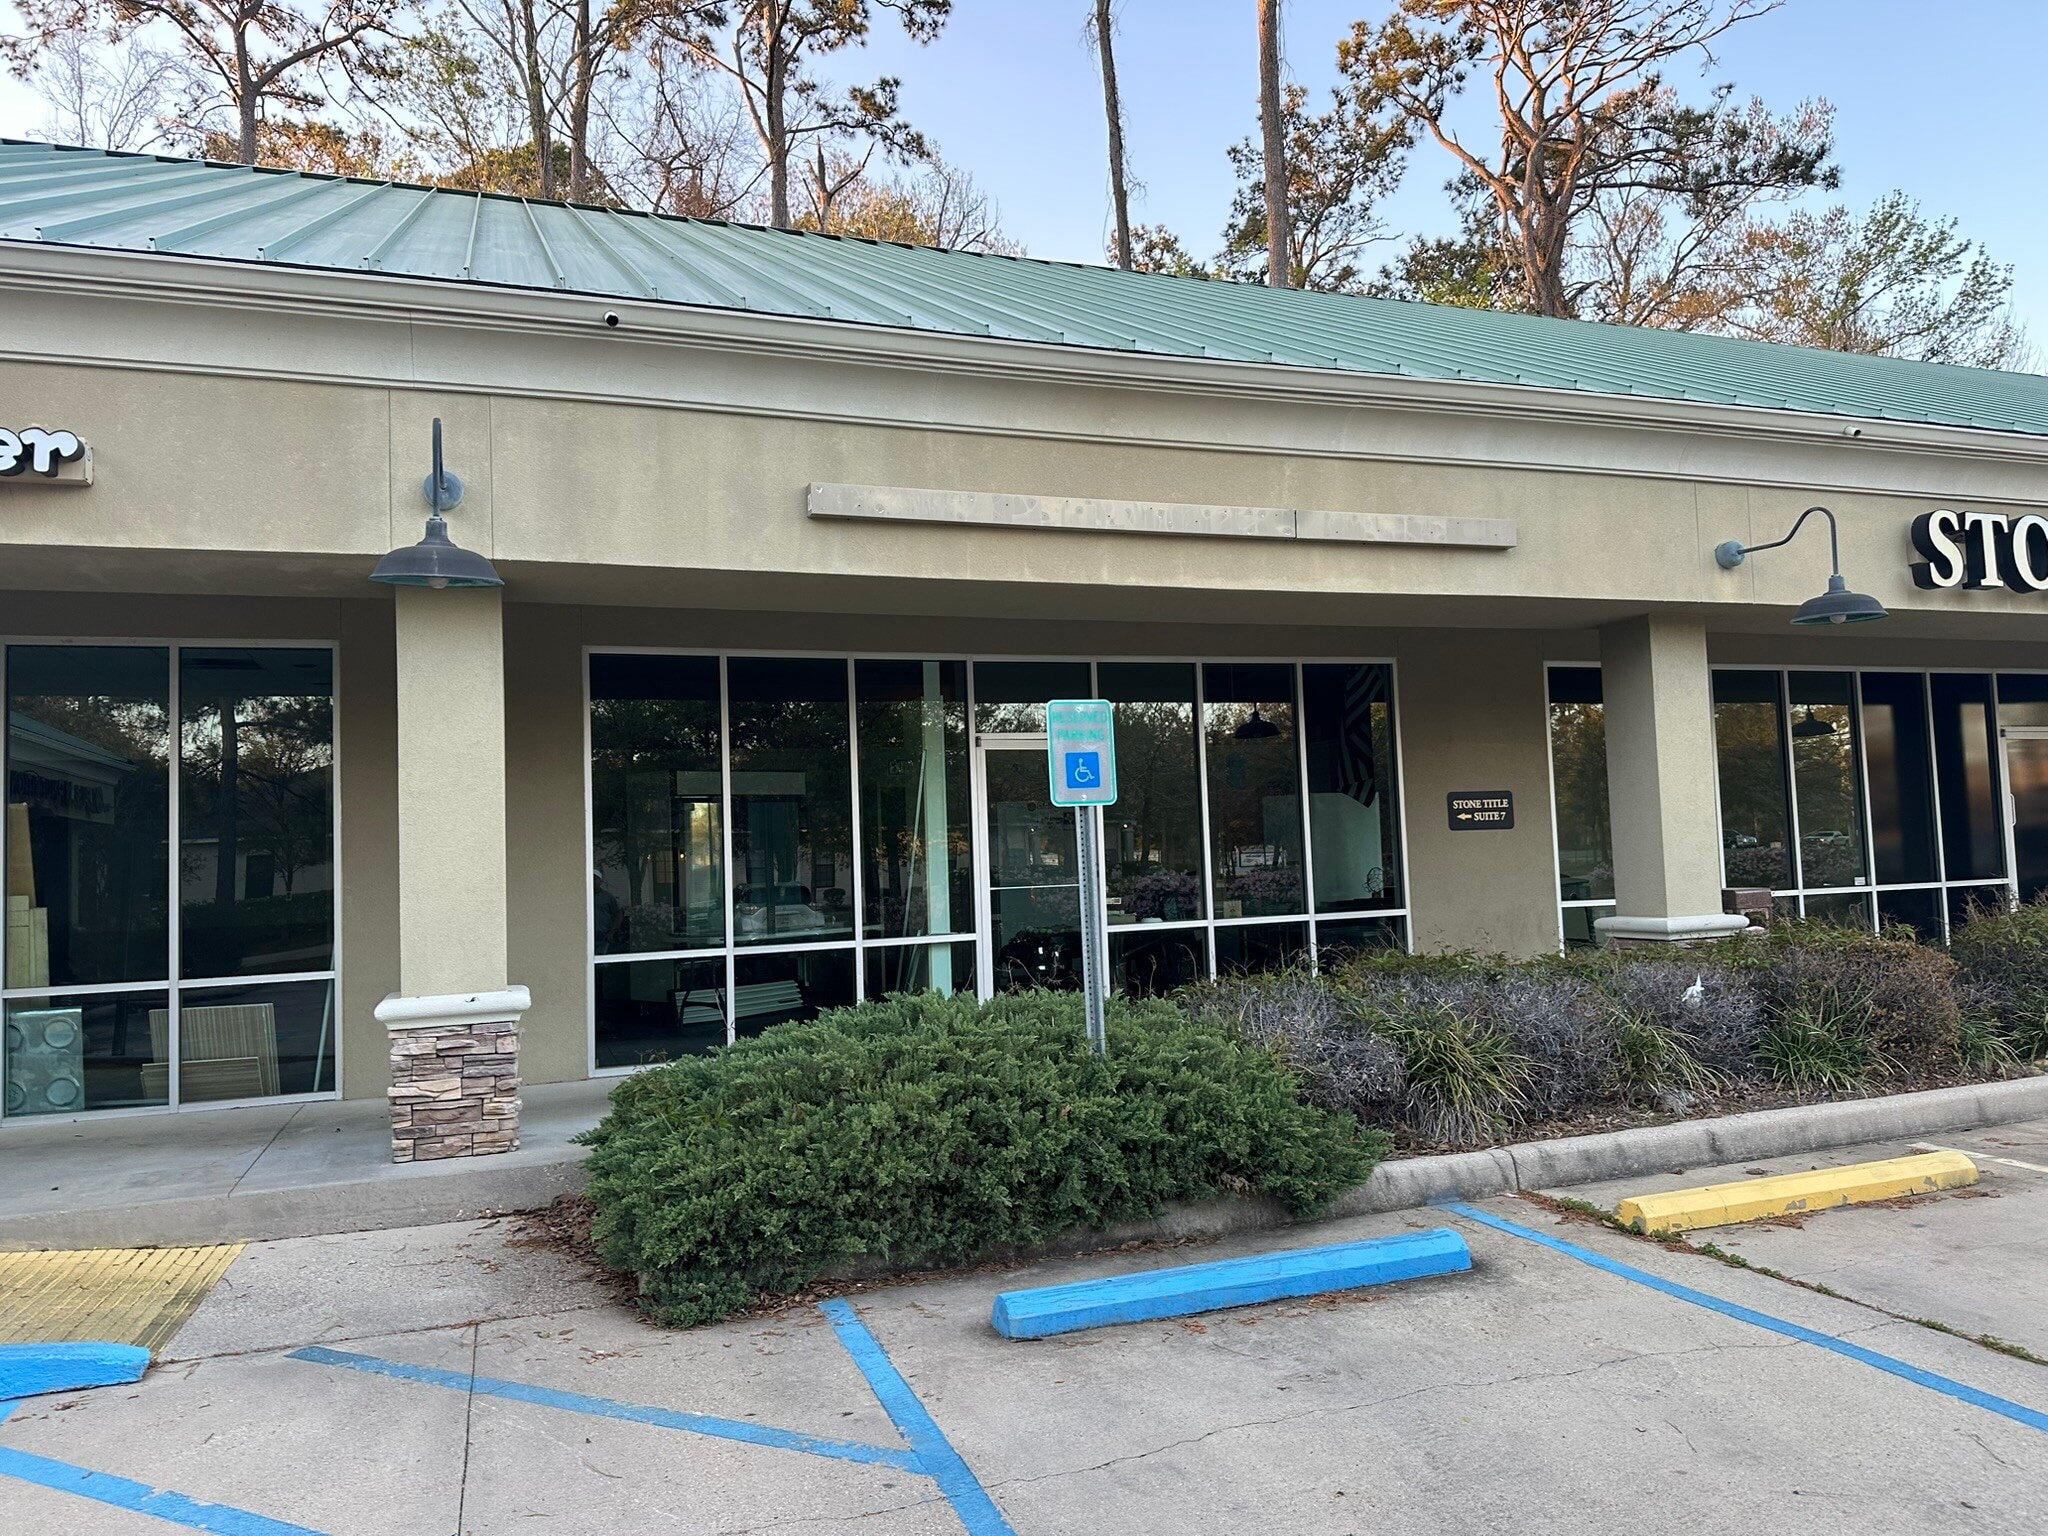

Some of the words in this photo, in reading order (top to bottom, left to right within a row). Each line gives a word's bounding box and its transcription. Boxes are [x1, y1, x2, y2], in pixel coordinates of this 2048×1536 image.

[1920, 509, 2048, 591] STO
[1057, 729, 1105, 742] PARKING
[1452, 800, 1482, 809] STONE
[1482, 799, 1509, 808] TITLE
[1473, 812, 1500, 821] SUITE
[1500, 812, 1506, 820] 7
